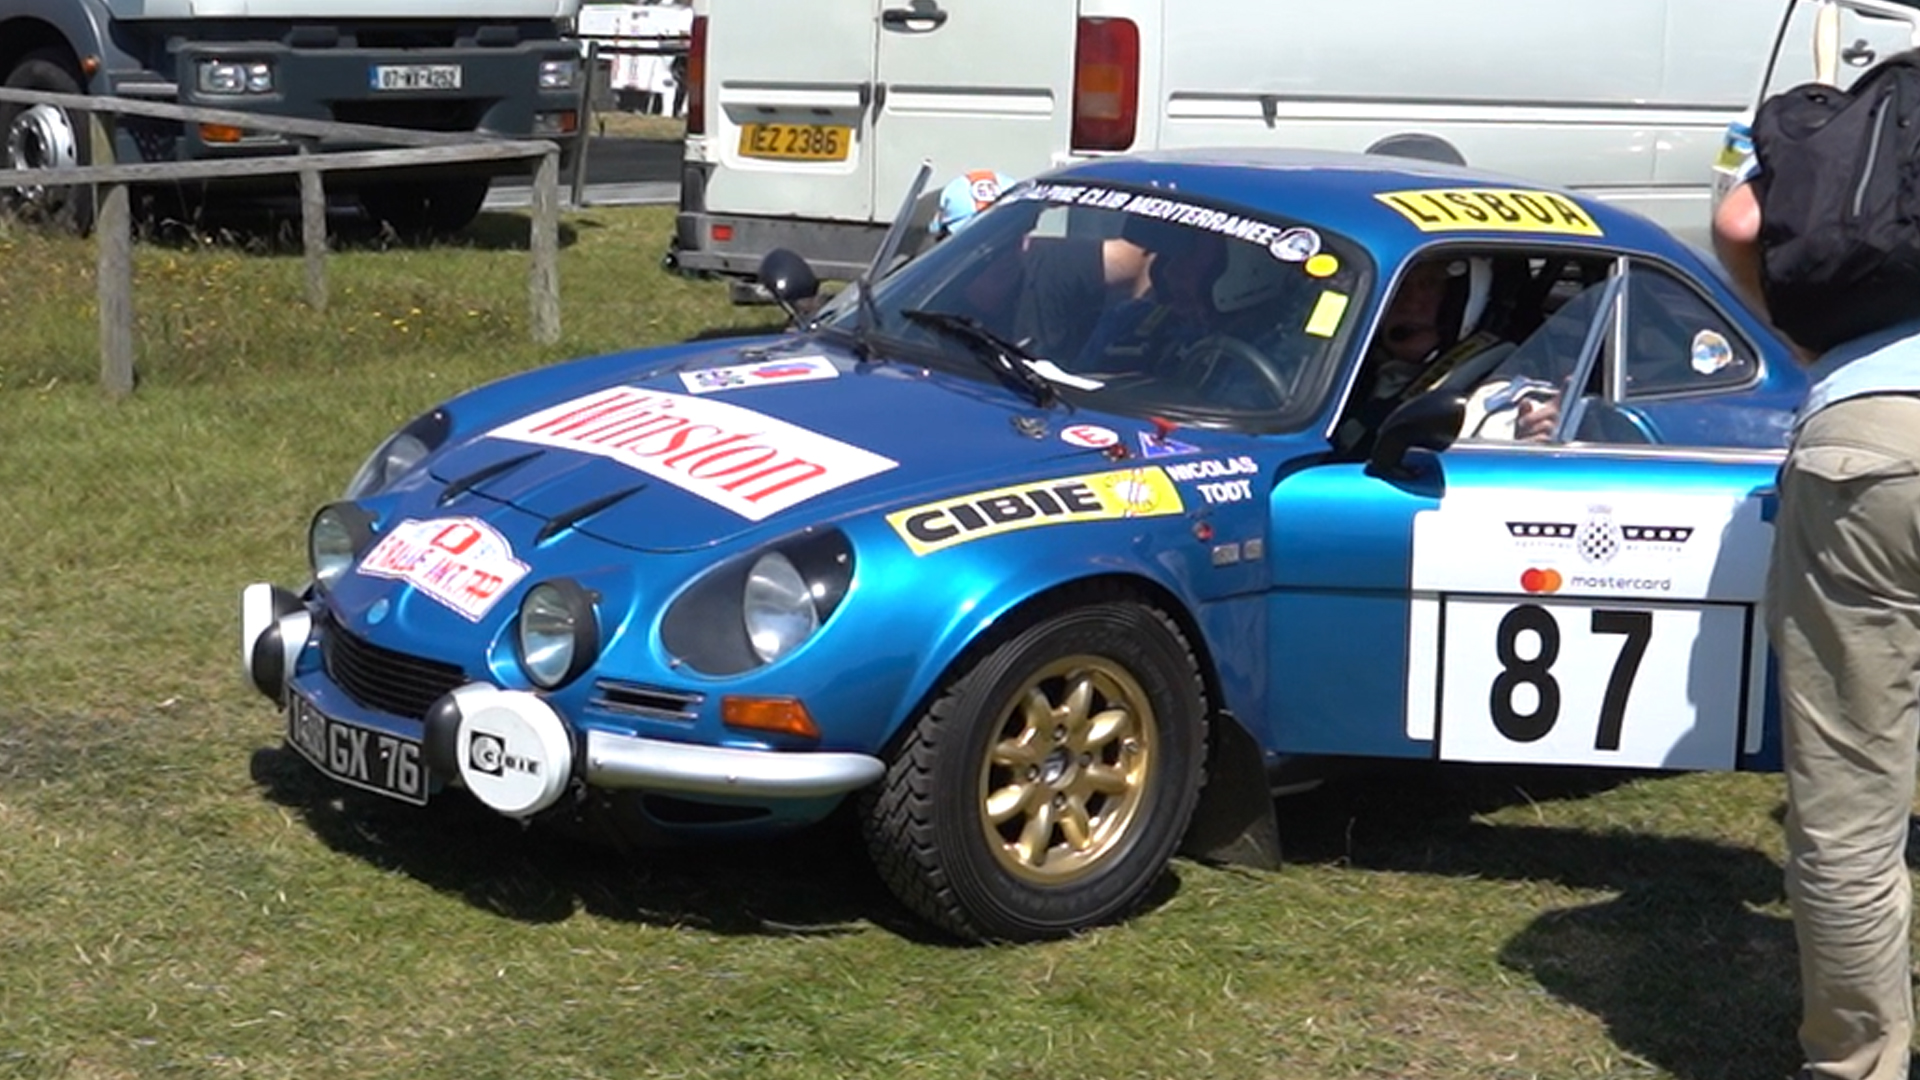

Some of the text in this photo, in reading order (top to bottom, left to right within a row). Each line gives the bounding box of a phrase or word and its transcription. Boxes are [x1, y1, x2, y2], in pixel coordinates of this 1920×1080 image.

[748, 125, 840, 155] IEZ 2386
[1078, 186, 1132, 210] CLUB
[1122, 195, 1282, 246] MEDITERRANEE
[1389, 192, 1588, 228] LISBOA
[528, 392, 828, 504] Winston
[1068, 426, 1111, 446] E
[1164, 456, 1259, 482] NICOLAS
[1570, 575, 1672, 591] mastercard
[1488, 602, 1654, 752] 87
[329, 723, 369, 781] GX
[378, 735, 420, 795] 76
